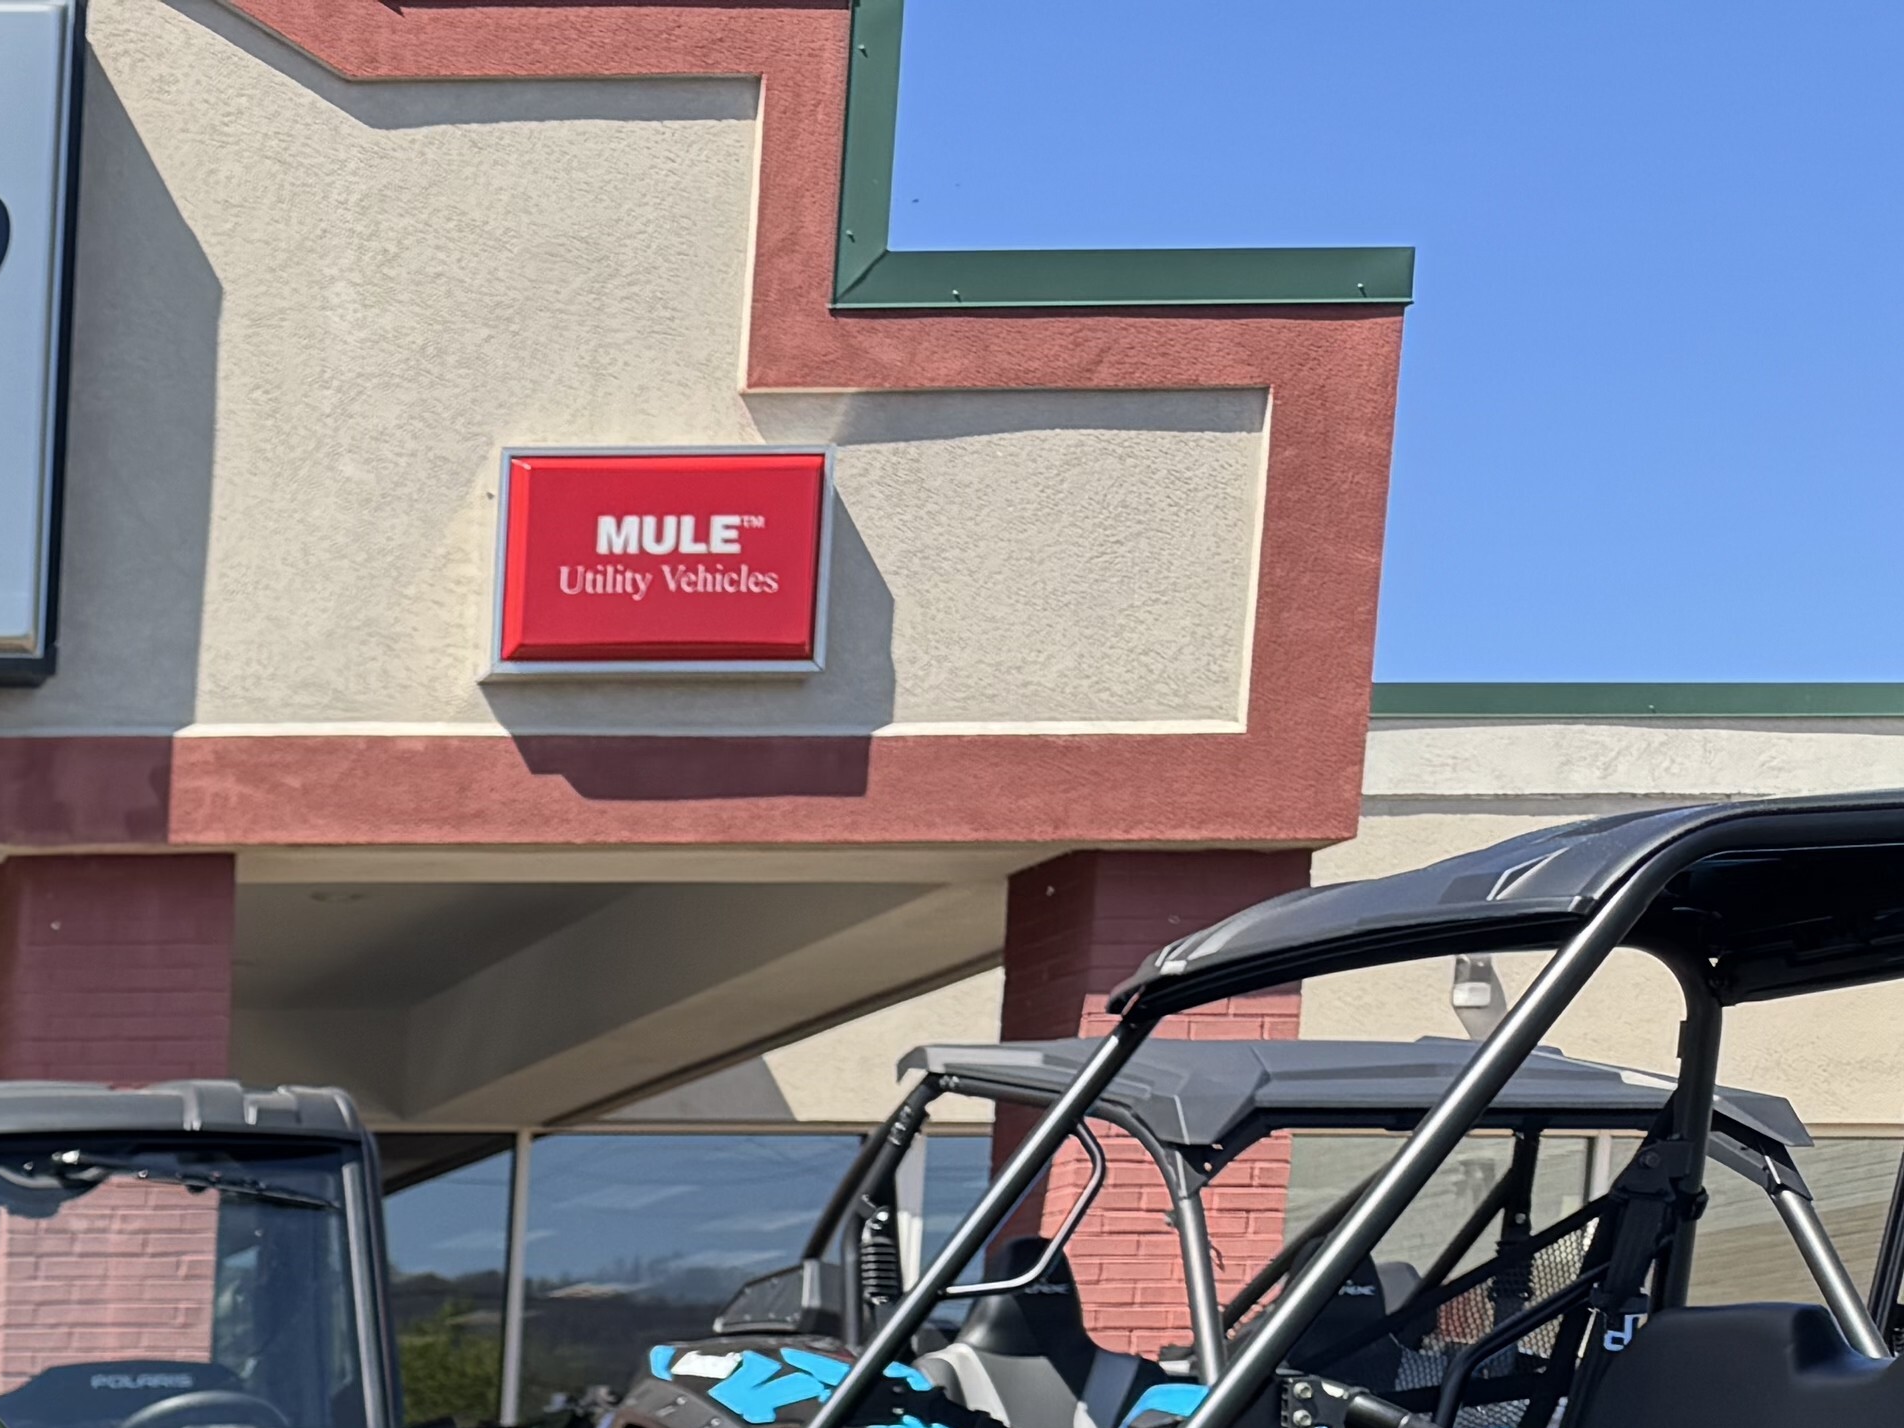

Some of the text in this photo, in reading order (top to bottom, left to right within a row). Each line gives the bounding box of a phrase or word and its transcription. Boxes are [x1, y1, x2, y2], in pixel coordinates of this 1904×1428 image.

[559, 564, 779, 600] Utility Vehicles
[91, 1373, 193, 1390] POLARIS
